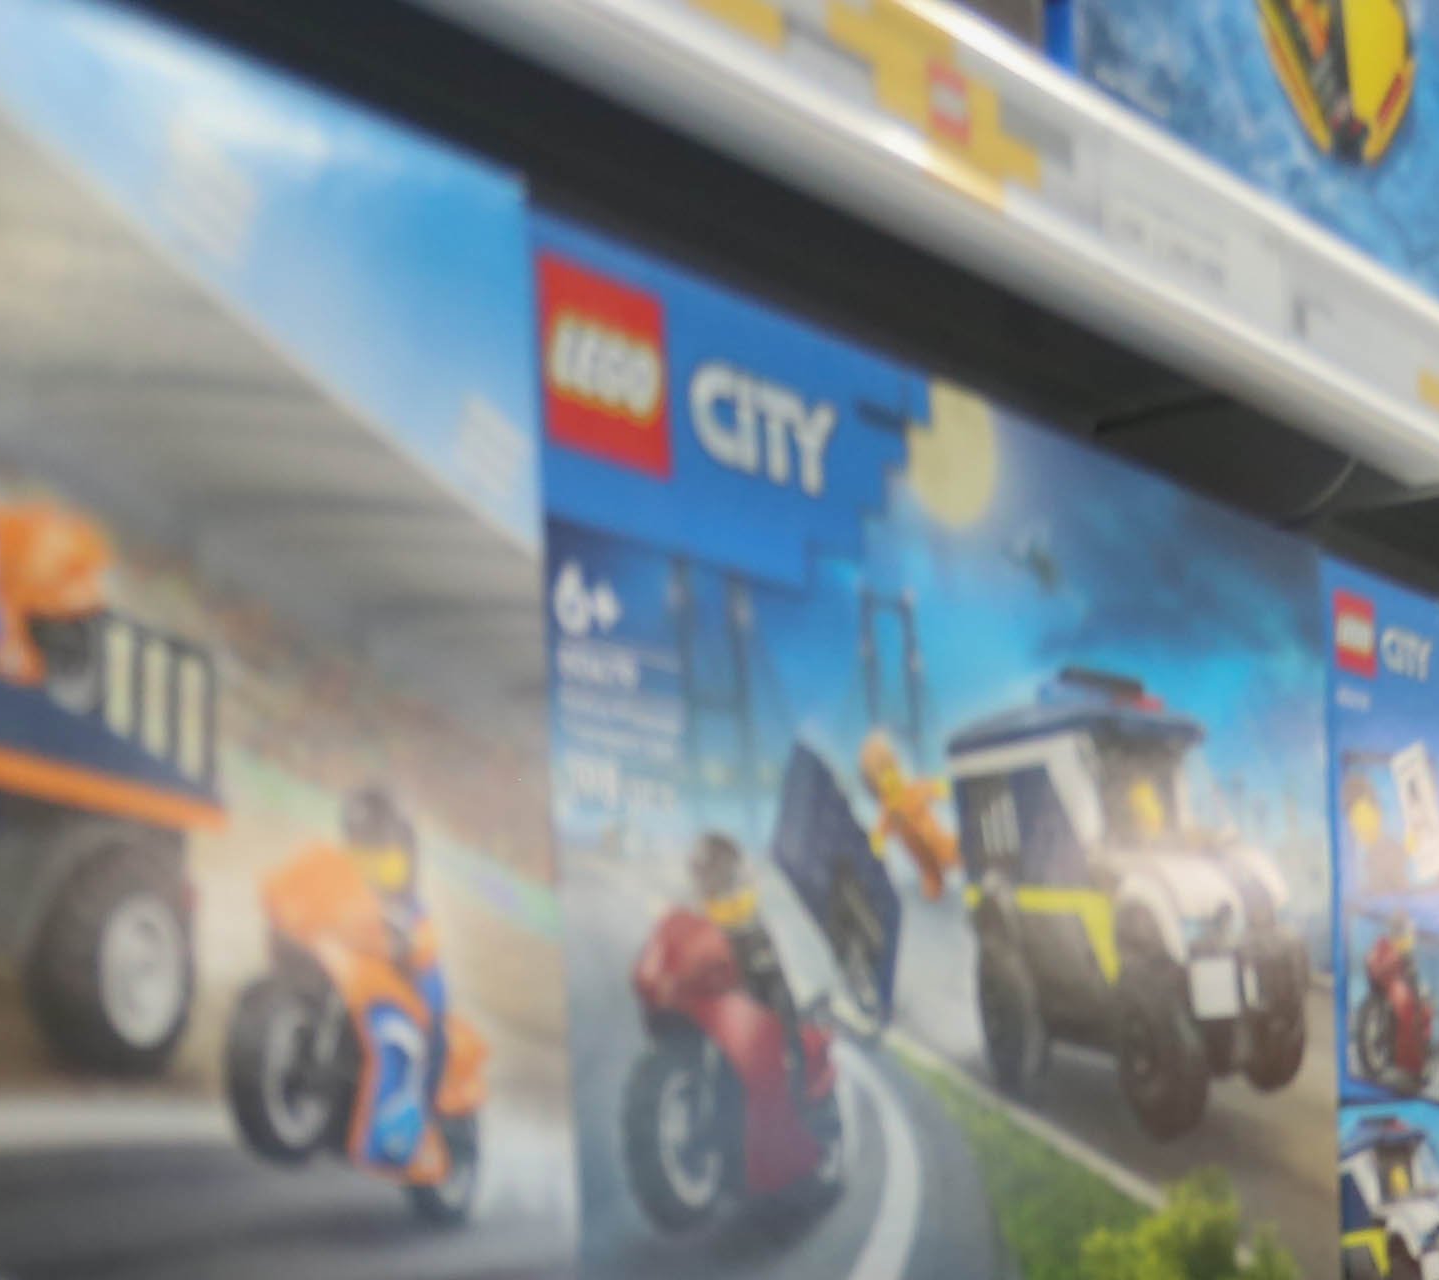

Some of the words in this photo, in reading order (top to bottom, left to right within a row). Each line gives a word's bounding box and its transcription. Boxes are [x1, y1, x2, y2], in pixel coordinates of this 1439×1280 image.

[549, 316, 661, 418] LEGO
[689, 362, 836, 495] CITY
[1381, 625, 1432, 682] CITY
